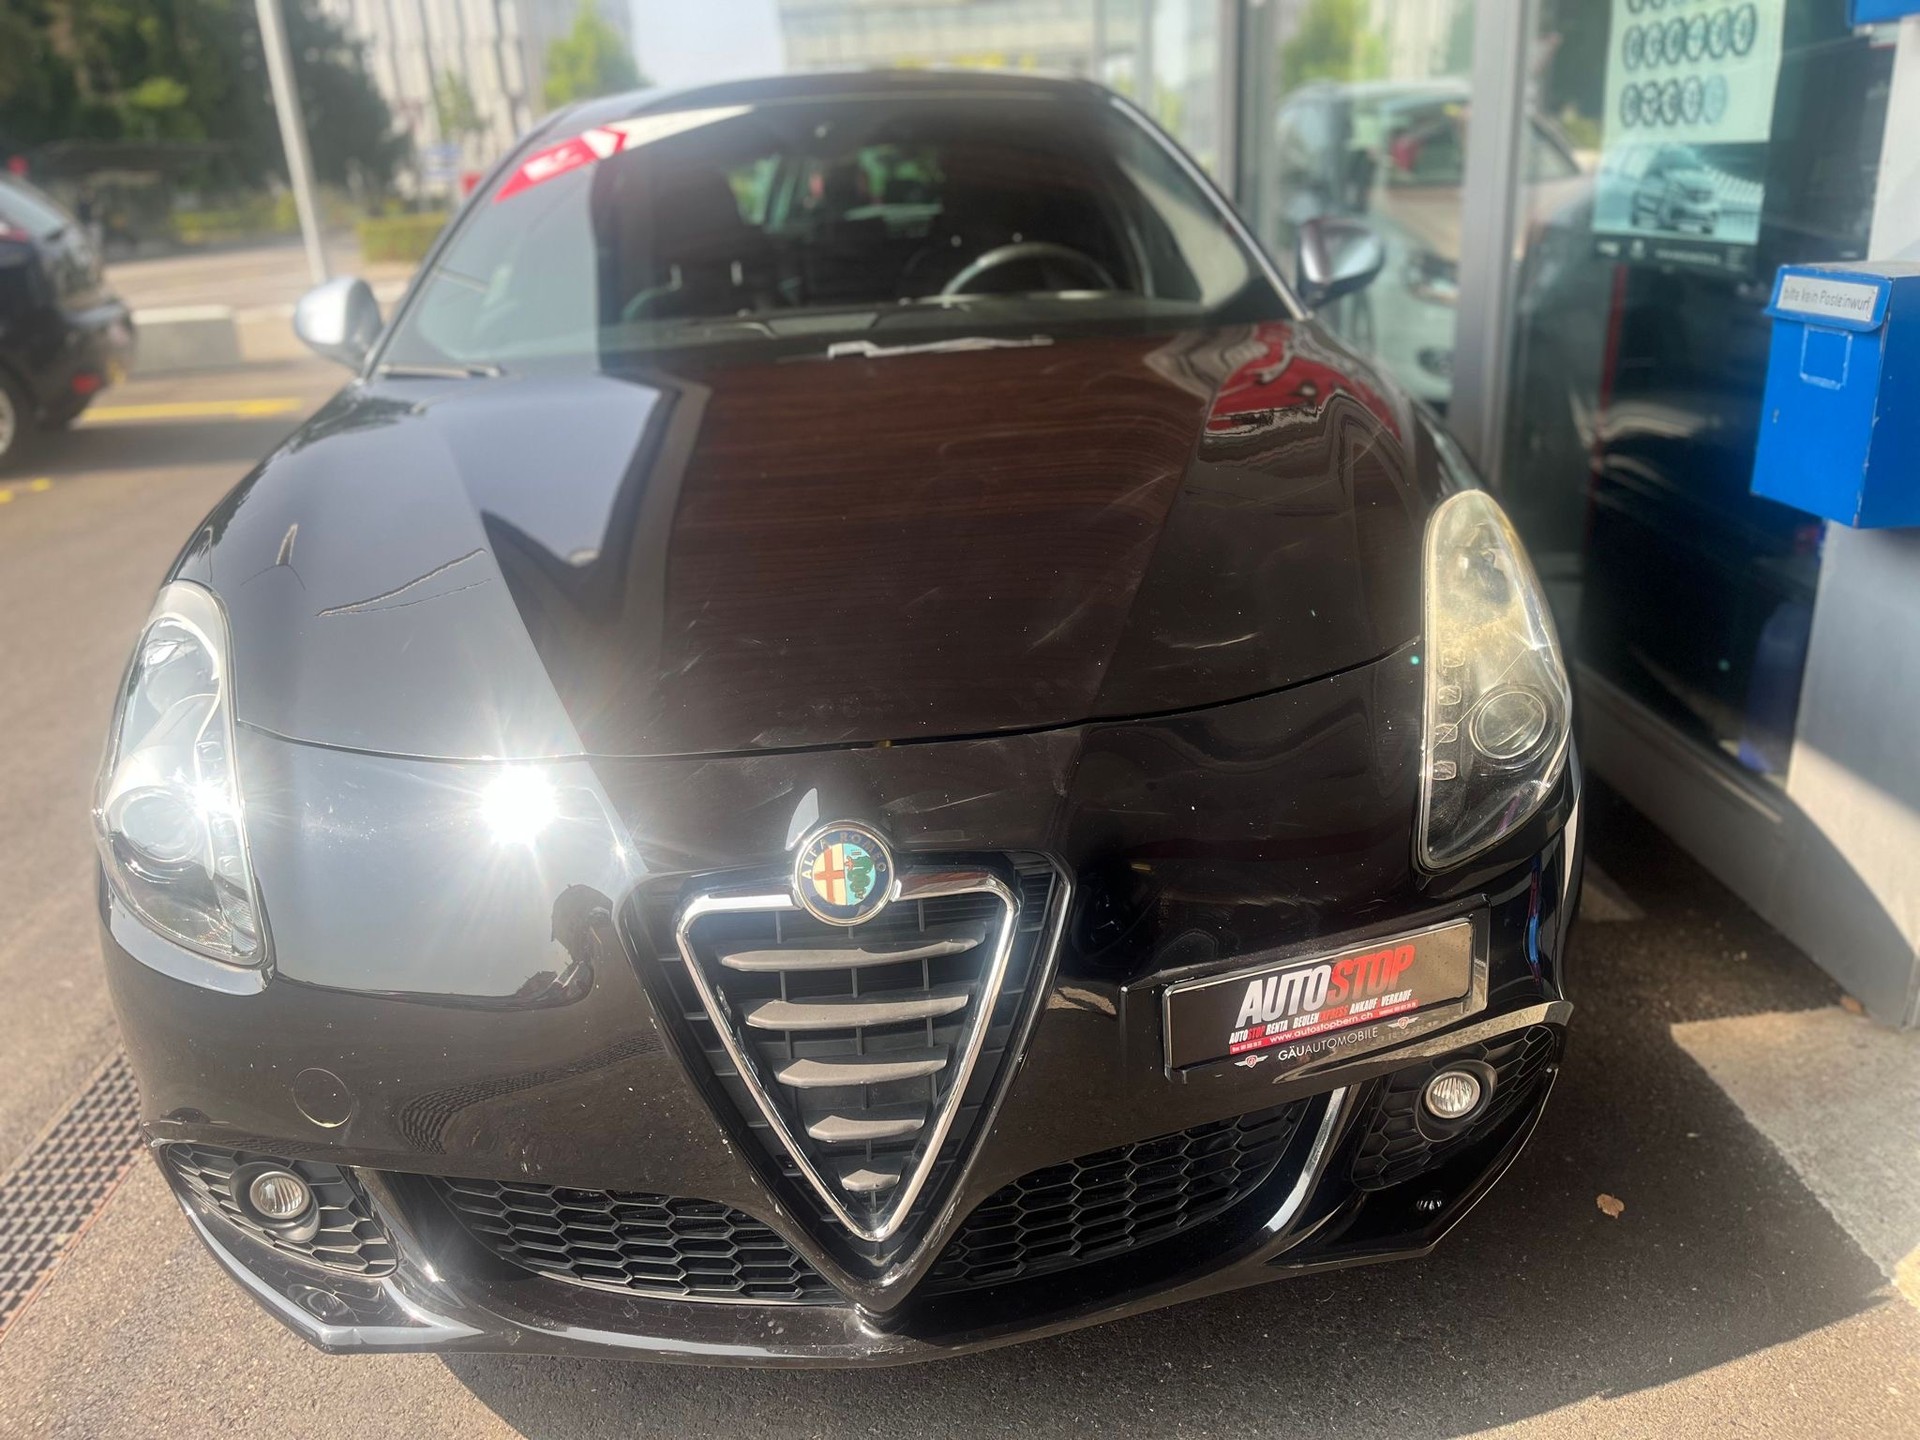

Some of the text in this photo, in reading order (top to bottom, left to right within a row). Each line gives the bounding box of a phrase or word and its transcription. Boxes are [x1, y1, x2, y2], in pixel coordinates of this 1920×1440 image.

[1235, 944, 1416, 1028] AUTOSTOP
[1349, 997, 1378, 1015] ANKAUF
[1381, 989, 1412, 1007] VERKAUF
[1270, 1011, 1373, 1043] www.autostopbern.ch
